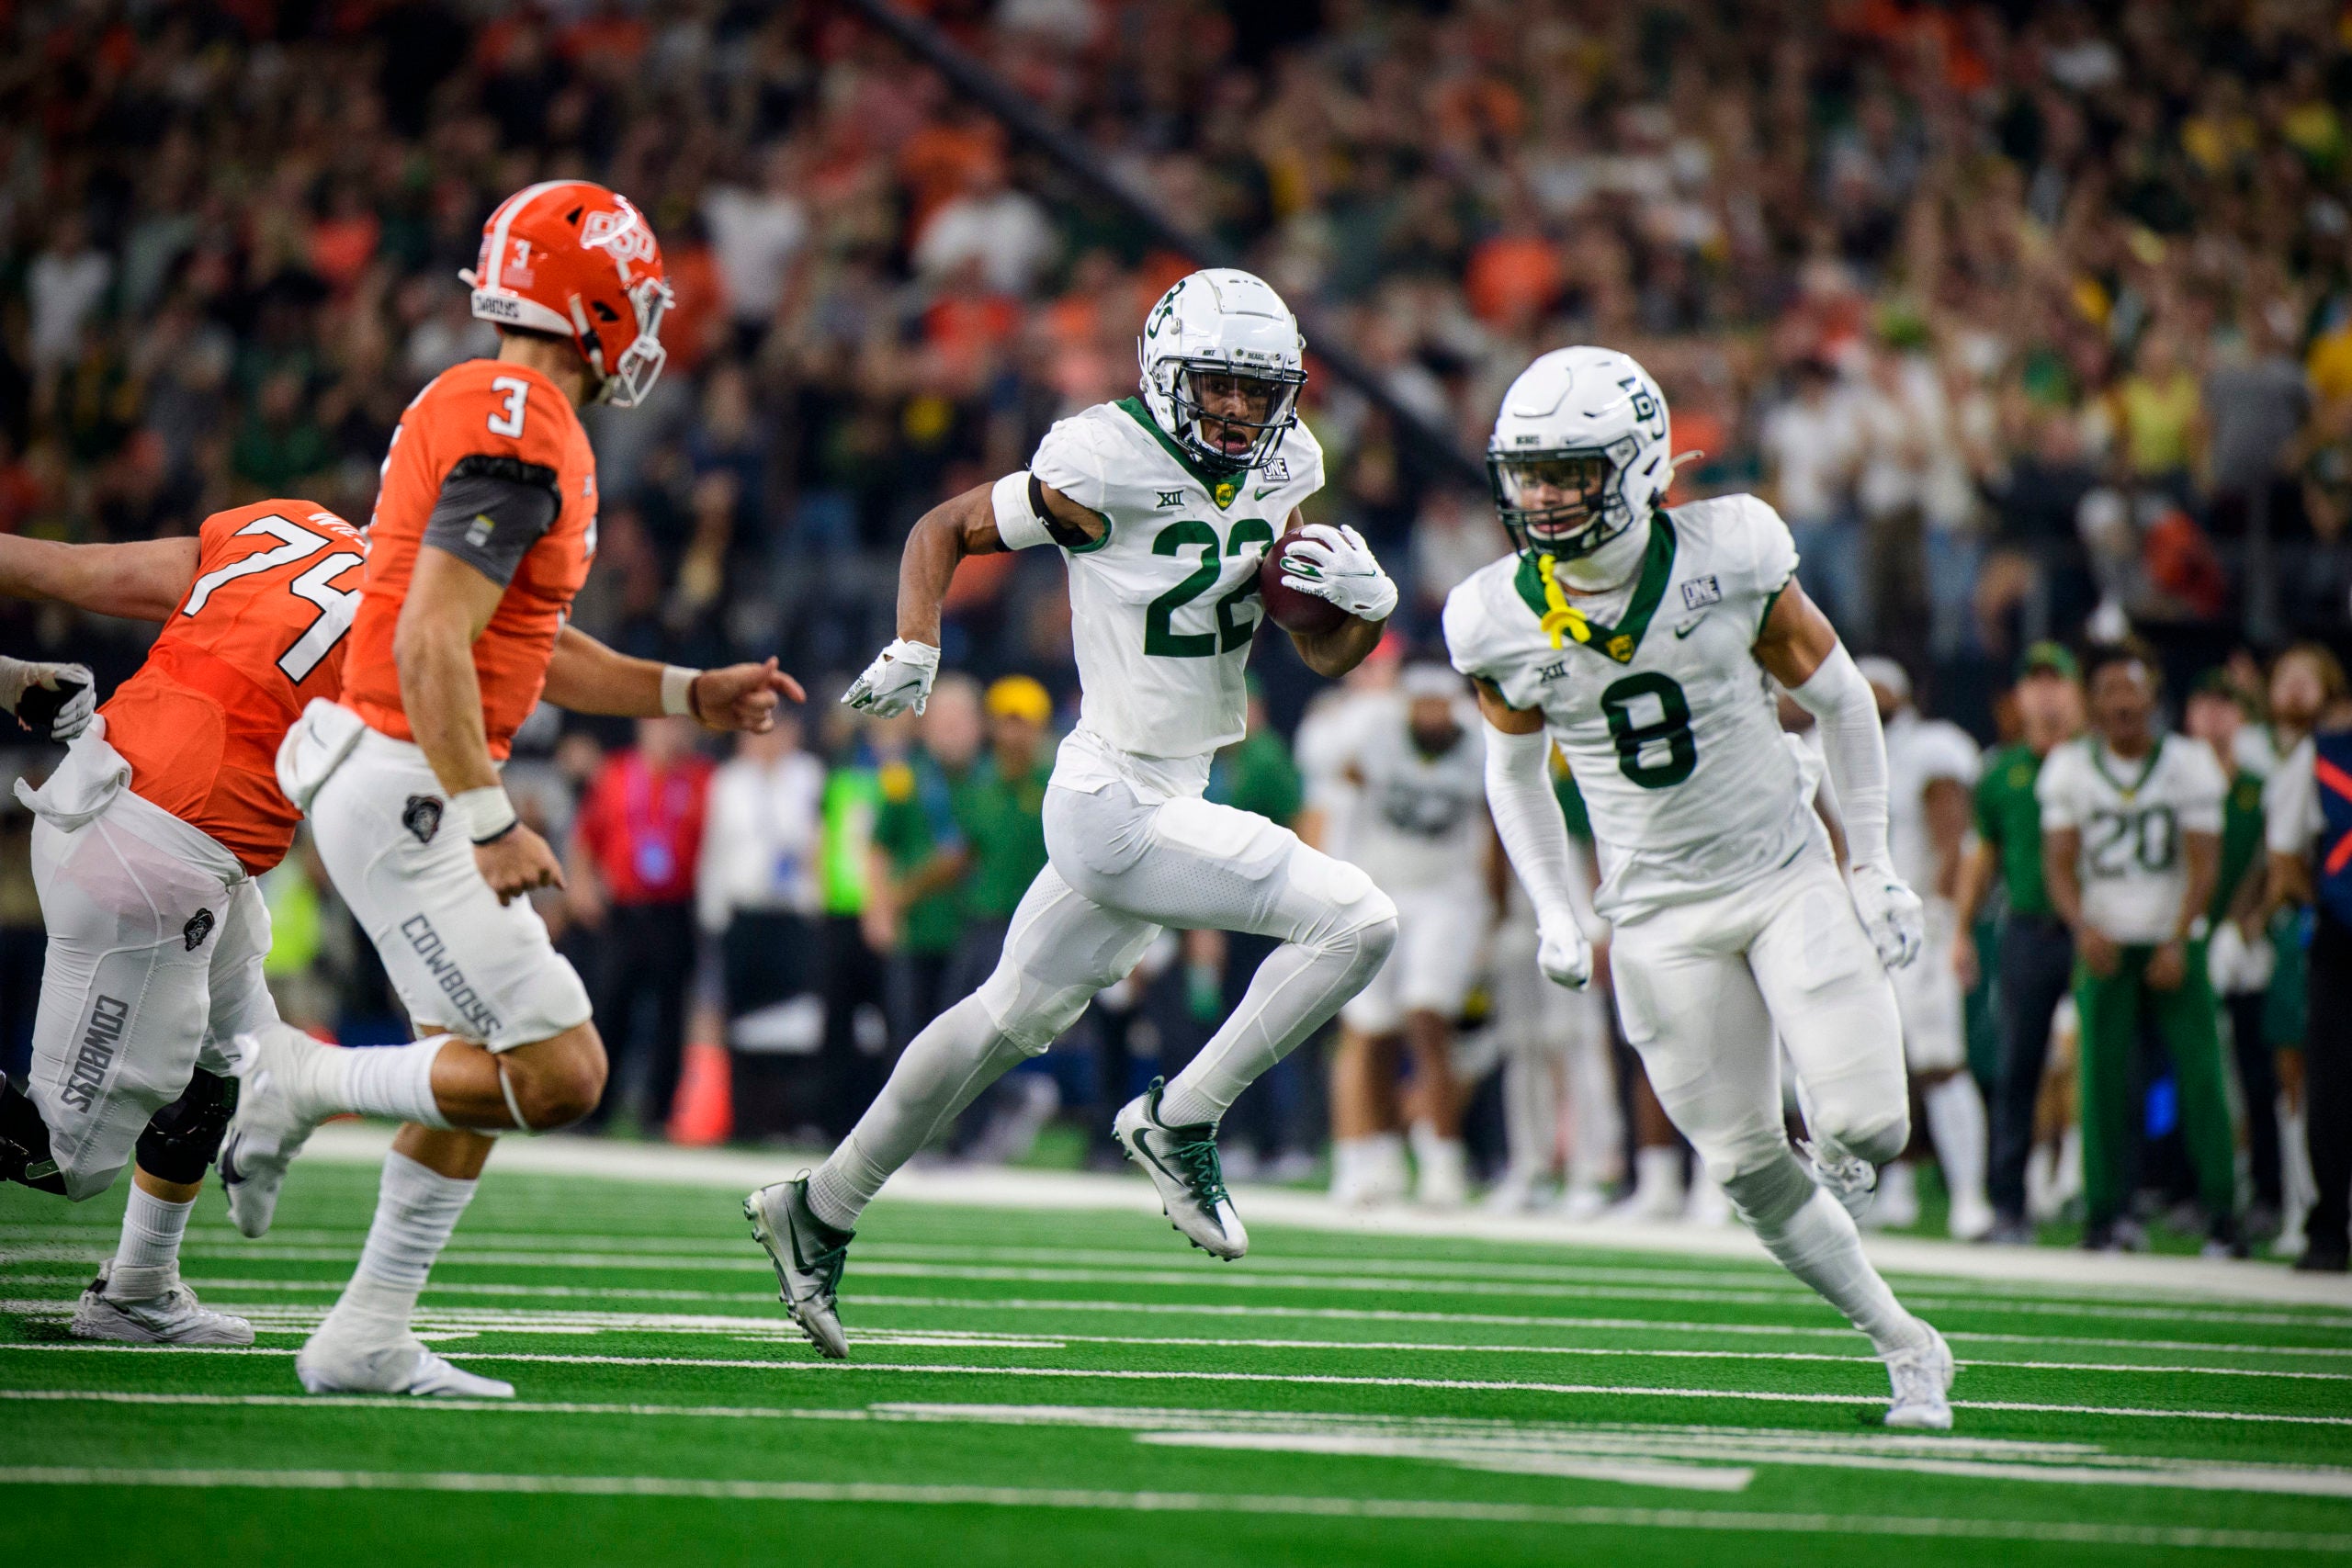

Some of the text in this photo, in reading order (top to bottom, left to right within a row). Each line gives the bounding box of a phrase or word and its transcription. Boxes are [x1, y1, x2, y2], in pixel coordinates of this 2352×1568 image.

[488, 377, 530, 438] 3
[1248, 352, 1265, 361] BEARS
[1156, 489, 1185, 509] XII
[181, 513, 366, 687] 74
[1144, 518, 1275, 659] 22
[1600, 671, 1697, 789] 8
[2090, 801, 2180, 879] 20
[401, 912, 503, 1038] COWBOYS
[61, 994, 130, 1114] COWBOYS
